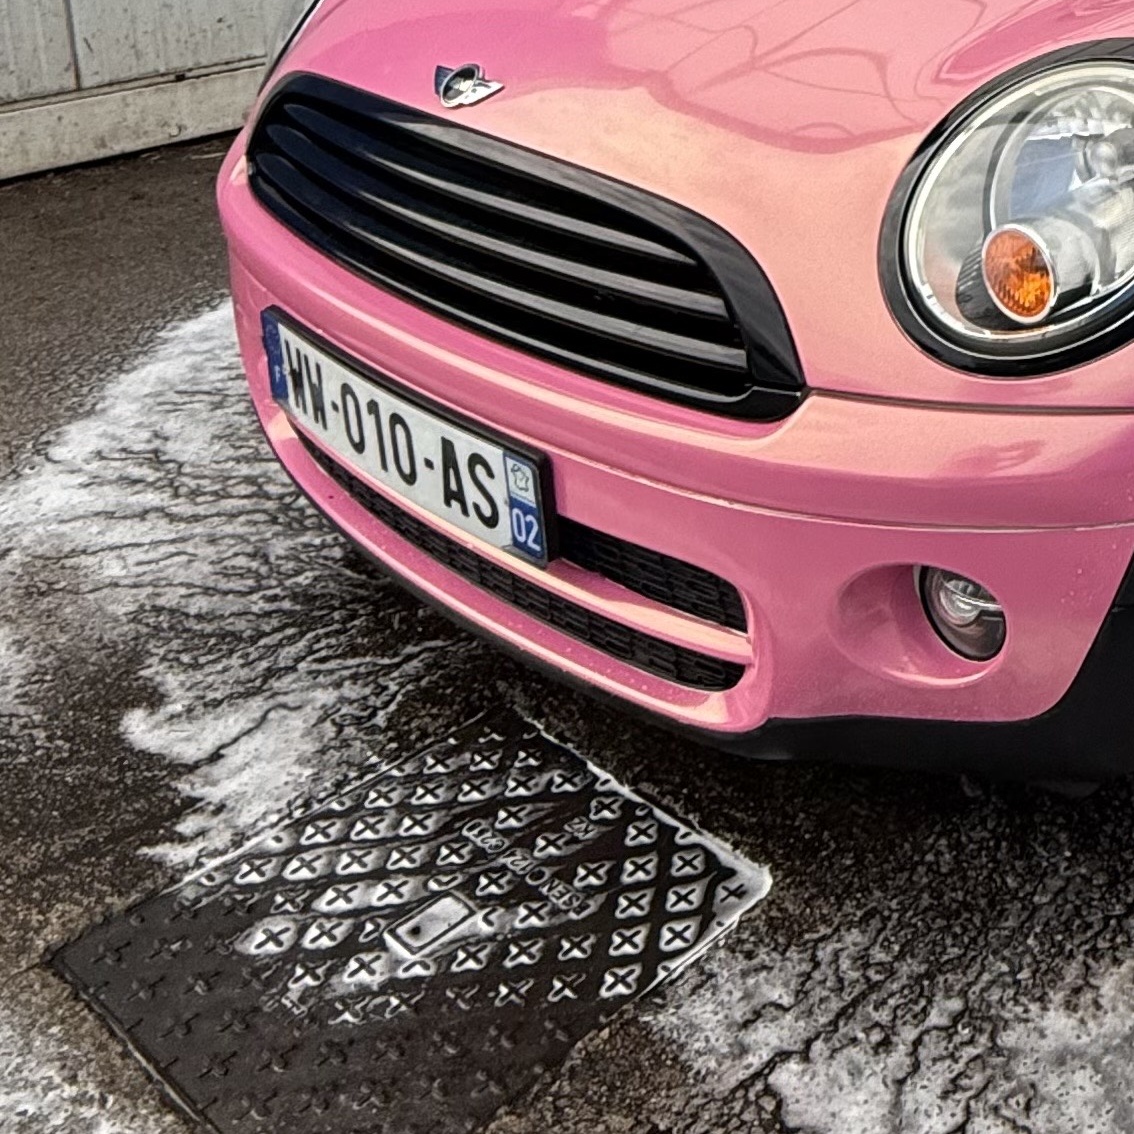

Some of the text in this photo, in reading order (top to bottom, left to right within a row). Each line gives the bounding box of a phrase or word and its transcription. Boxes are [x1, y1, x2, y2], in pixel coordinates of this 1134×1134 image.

[284, 339, 499, 529] WW-010-AS
[512, 507, 541, 552] 02
[503, 849, 534, 872] 124
